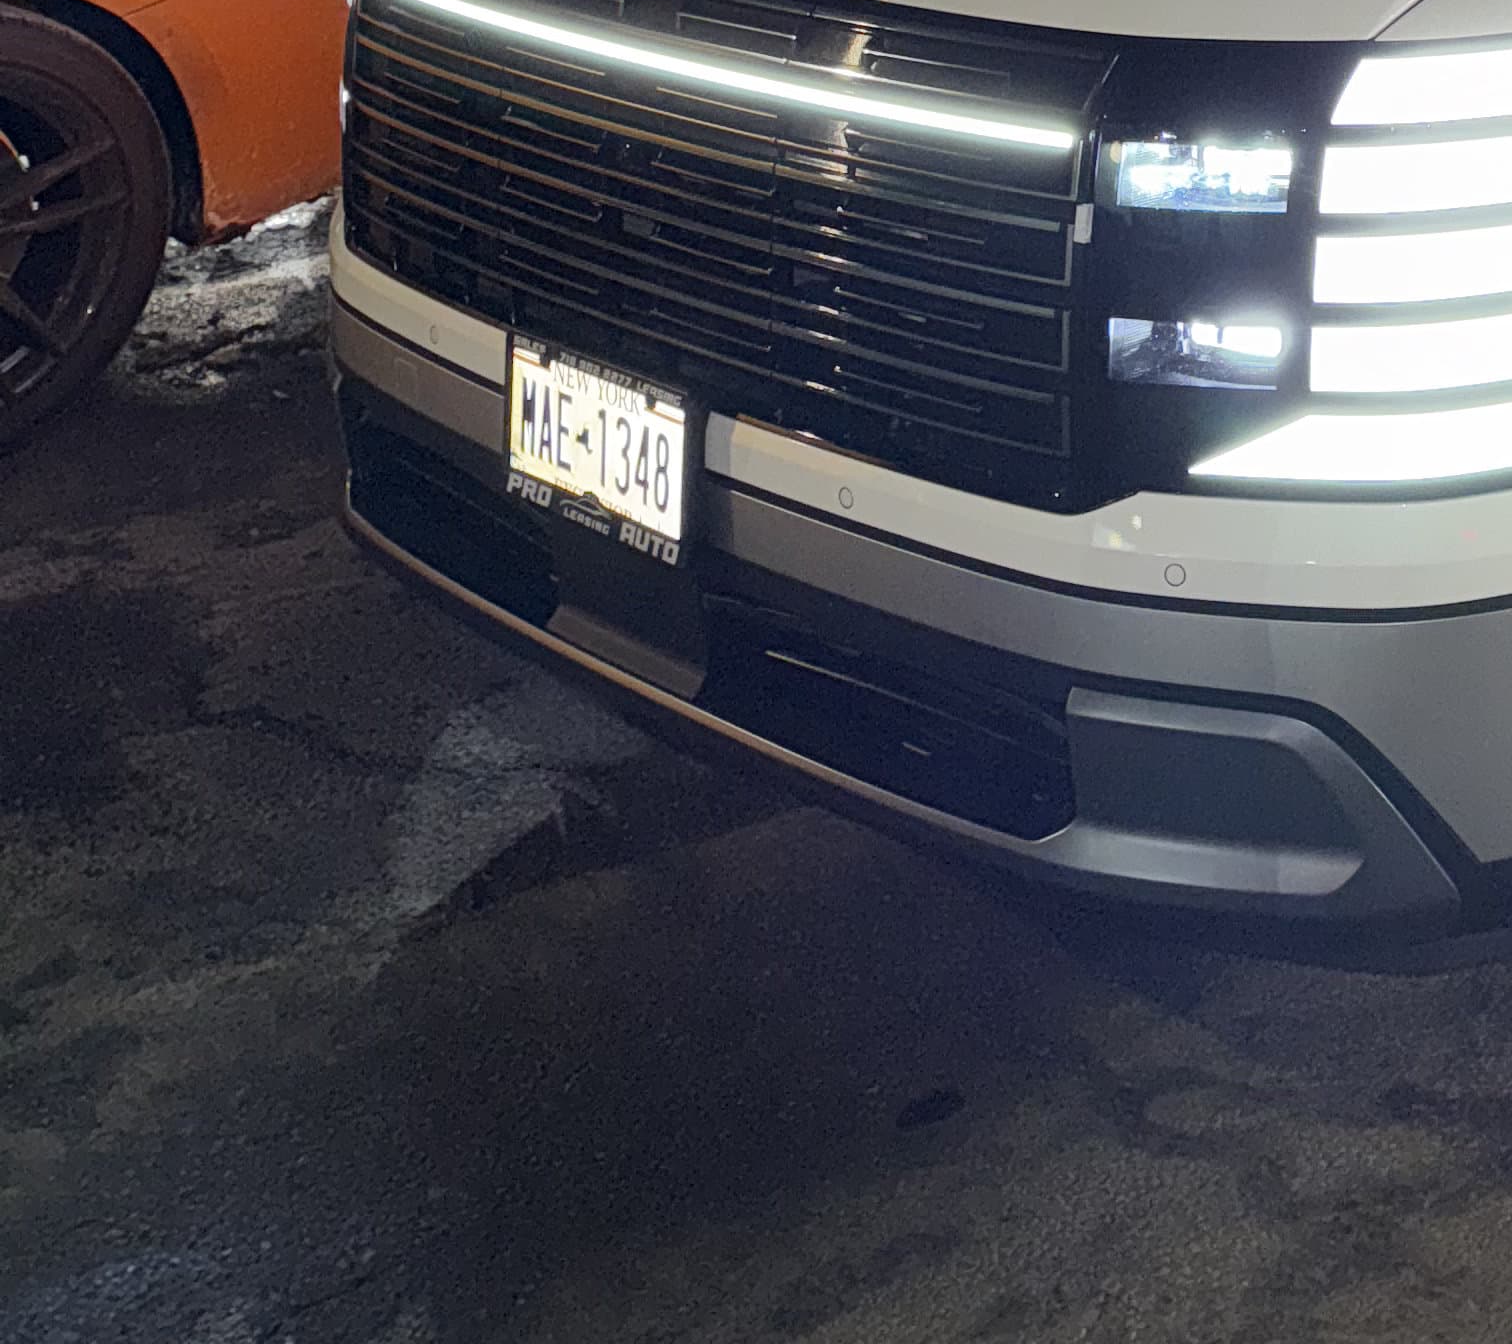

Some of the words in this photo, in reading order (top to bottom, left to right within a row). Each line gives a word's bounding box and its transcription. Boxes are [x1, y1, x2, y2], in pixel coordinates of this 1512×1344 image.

[553, 362, 592, 395] NEW
[597, 374, 641, 416] YORK
[636, 381, 682, 406] LEASING
[598, 408, 669, 513] 1348
[506, 472, 553, 508] PRO
[563, 507, 610, 535] LEASING
[619, 521, 680, 566] AUTO
